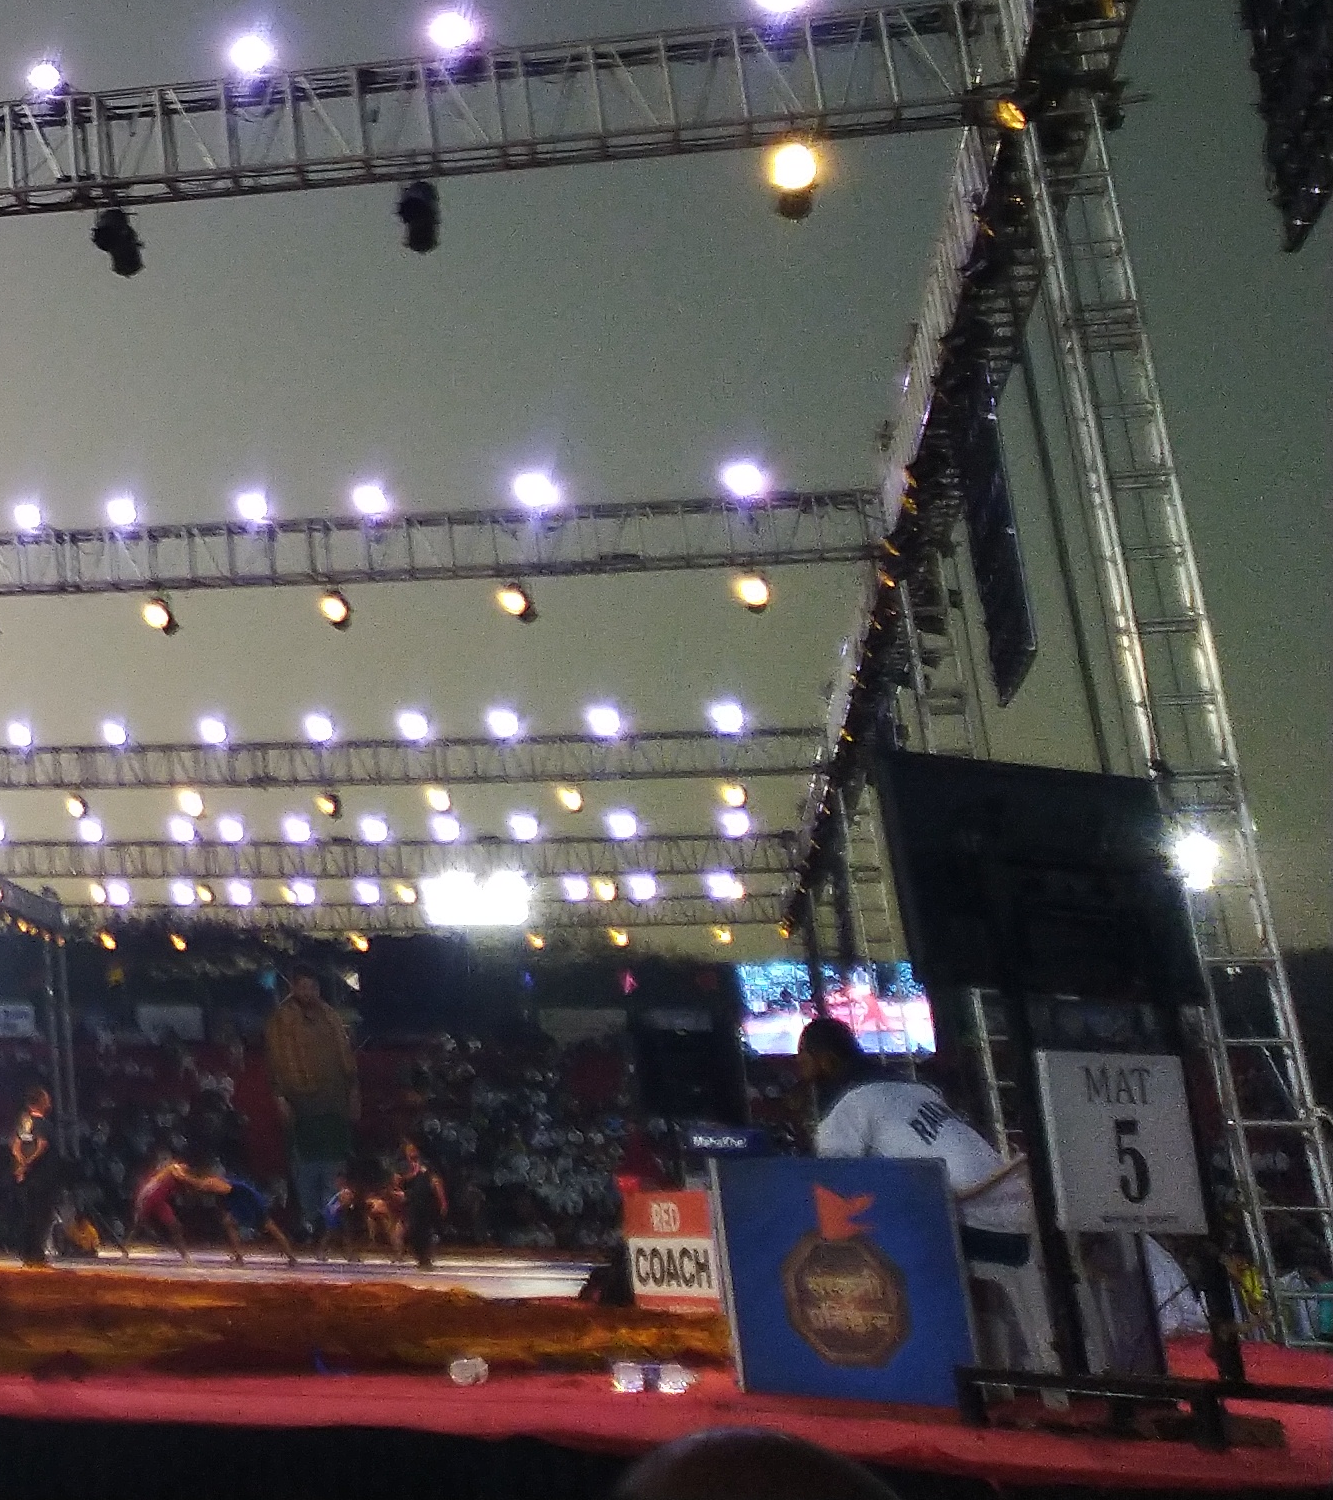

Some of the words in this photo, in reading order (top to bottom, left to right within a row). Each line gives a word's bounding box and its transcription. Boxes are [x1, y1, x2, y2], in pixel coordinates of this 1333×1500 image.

[1077, 1064, 1151, 1105] MAT
[1114, 1118, 1151, 1204] 5
[650, 1201, 681, 1233] RED
[635, 1247, 714, 1290] COACH
